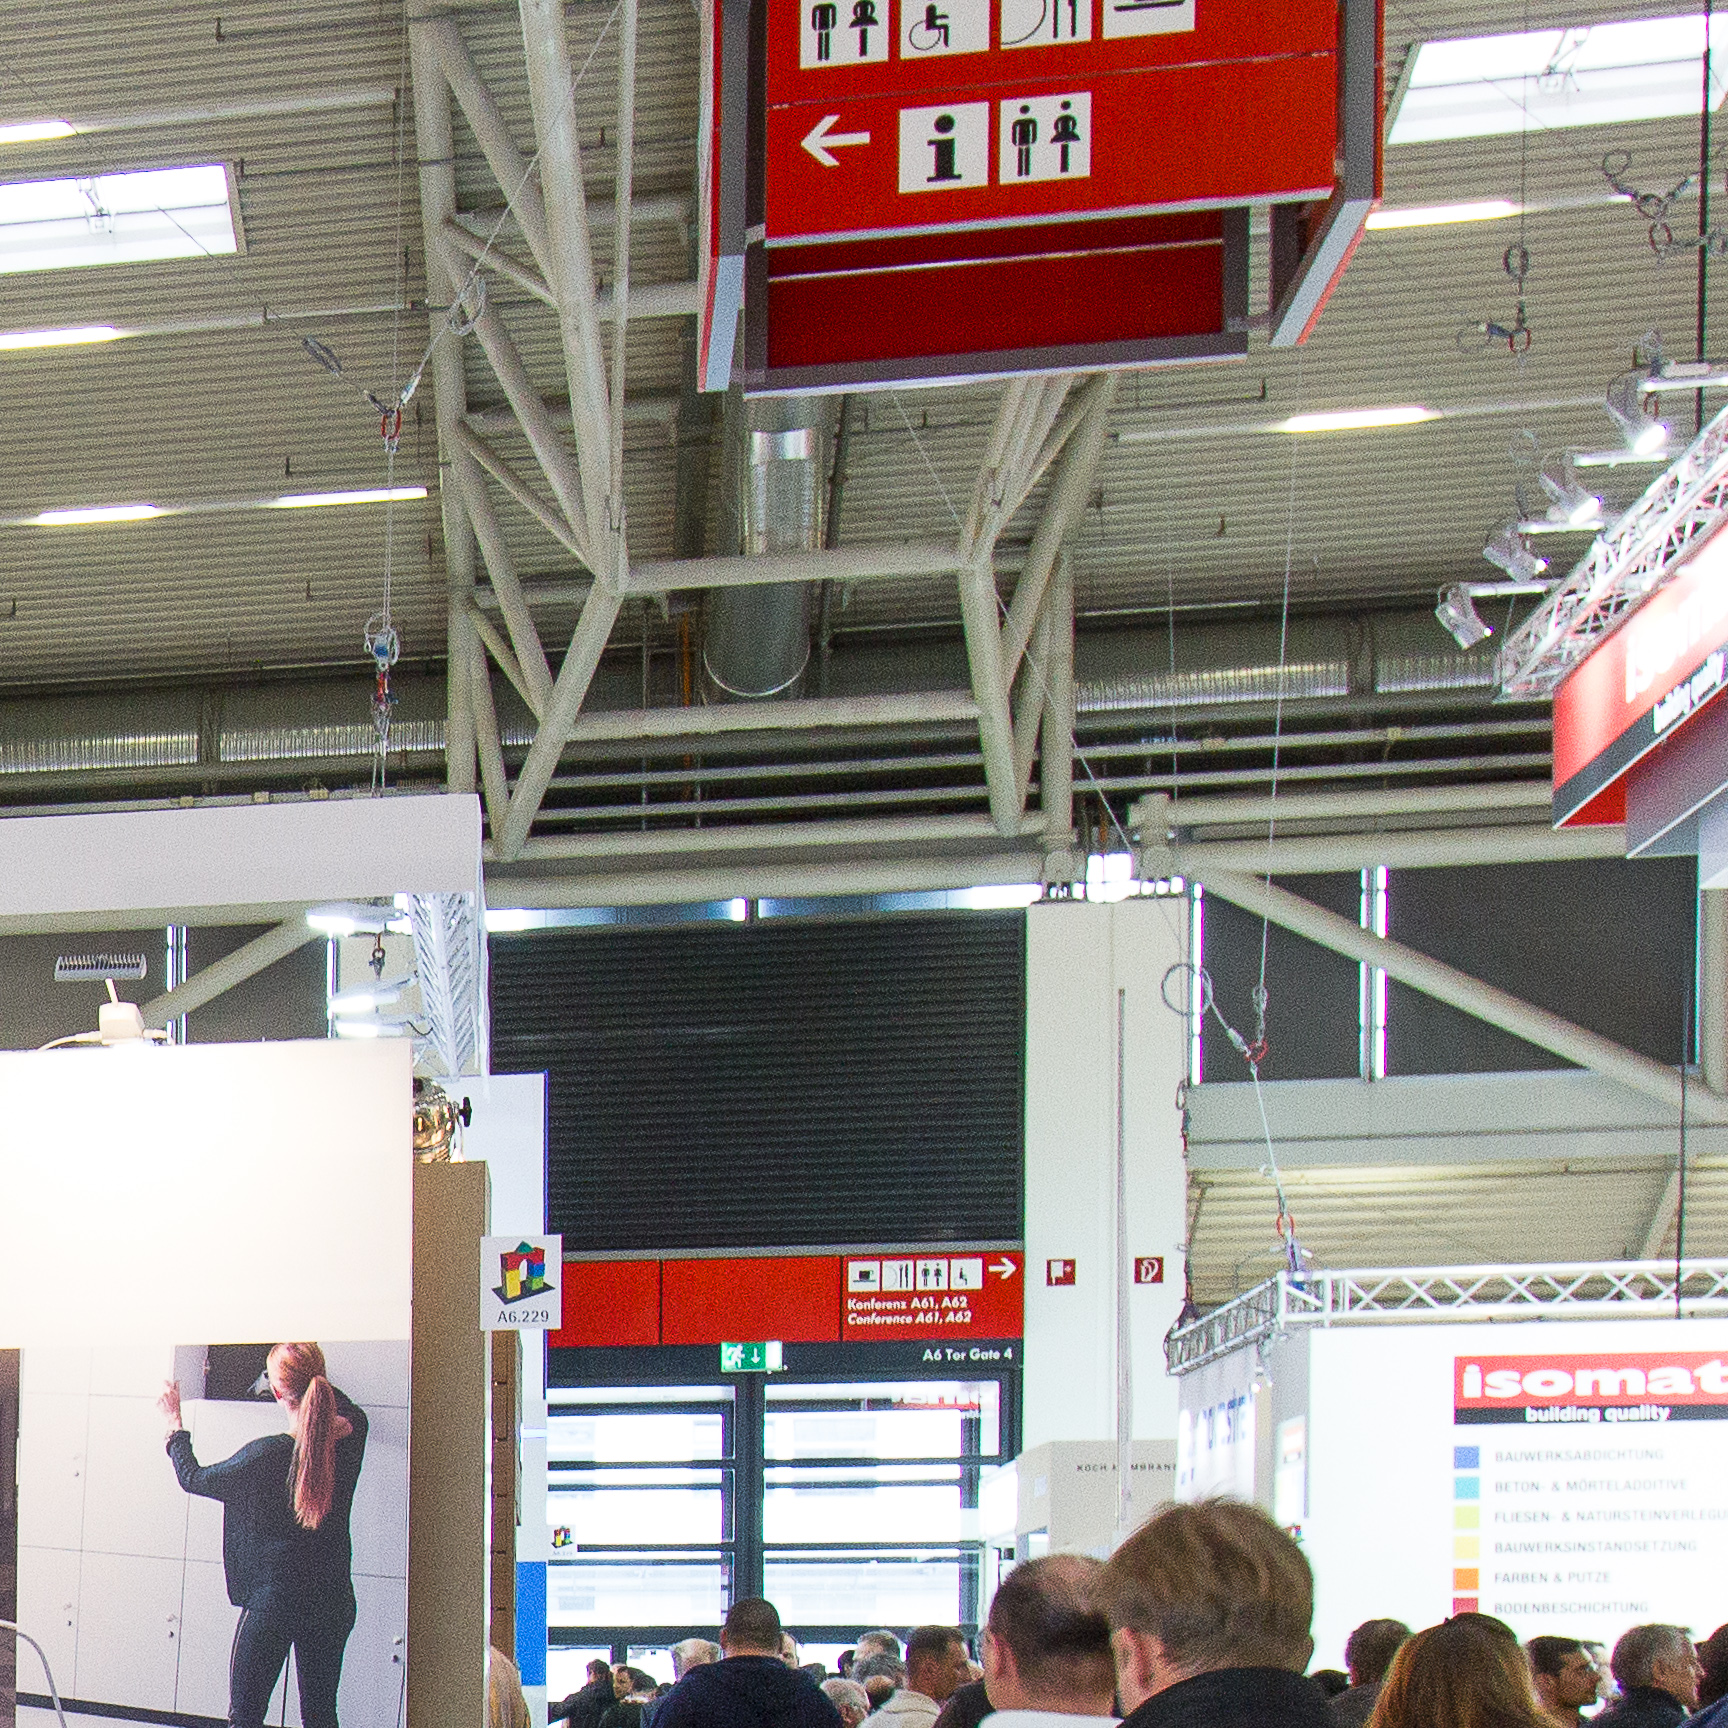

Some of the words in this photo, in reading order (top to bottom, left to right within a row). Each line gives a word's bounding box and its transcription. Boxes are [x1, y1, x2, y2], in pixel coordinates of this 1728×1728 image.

[848, 1298, 907, 1311] Konferenz
[941, 1296, 968, 1308] A62
[497, 1310, 549, 1323] A6.229
[848, 1312, 912, 1325] Conference
[945, 1310, 972, 1323] A62
[923, 1349, 942, 1361] A6
[945, 1349, 966, 1361] Tor
[970, 1347, 1000, 1360] Gate
[1004, 1347, 1013, 1360] 4
[1524, 1406, 1601, 1423] building
[1604, 1404, 1671, 1422] quality
[1495, 1450, 1664, 1463] BAUWERKSABDICHTUNG
[1551, 1482, 1561, 1492] &
[1562, 1512, 1571, 1522] &
[1576, 1508, 1728, 1522] NATURSTEINVERLEGU
[1494, 1571, 1548, 1584] FARBEN
[1553, 1572, 1562, 1583] &
[1494, 1601, 1649, 1615] BODENBESCHICHTUNG
